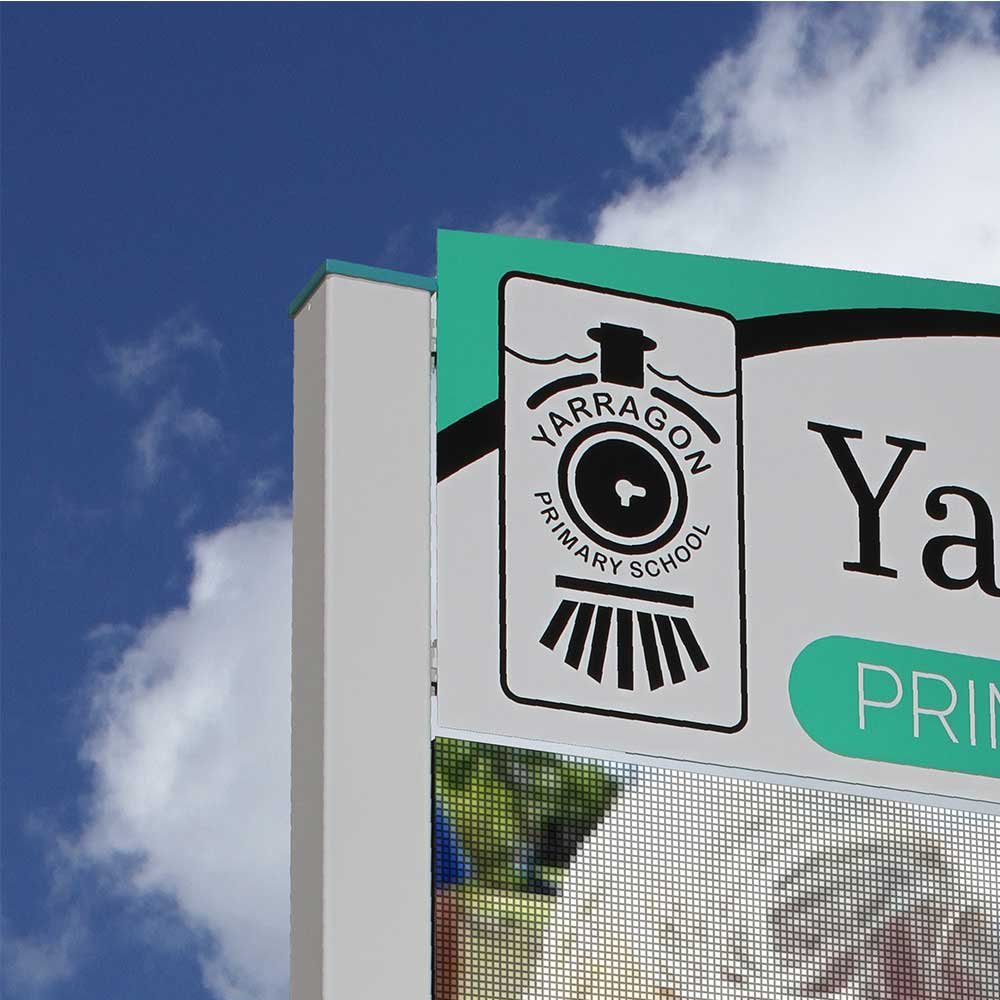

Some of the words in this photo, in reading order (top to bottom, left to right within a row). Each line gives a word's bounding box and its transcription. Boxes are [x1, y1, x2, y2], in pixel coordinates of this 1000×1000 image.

[530, 392, 712, 475] YARRAGON
[534, 491, 624, 576] PRIMARY
[631, 524, 711, 579] SCHOOL
